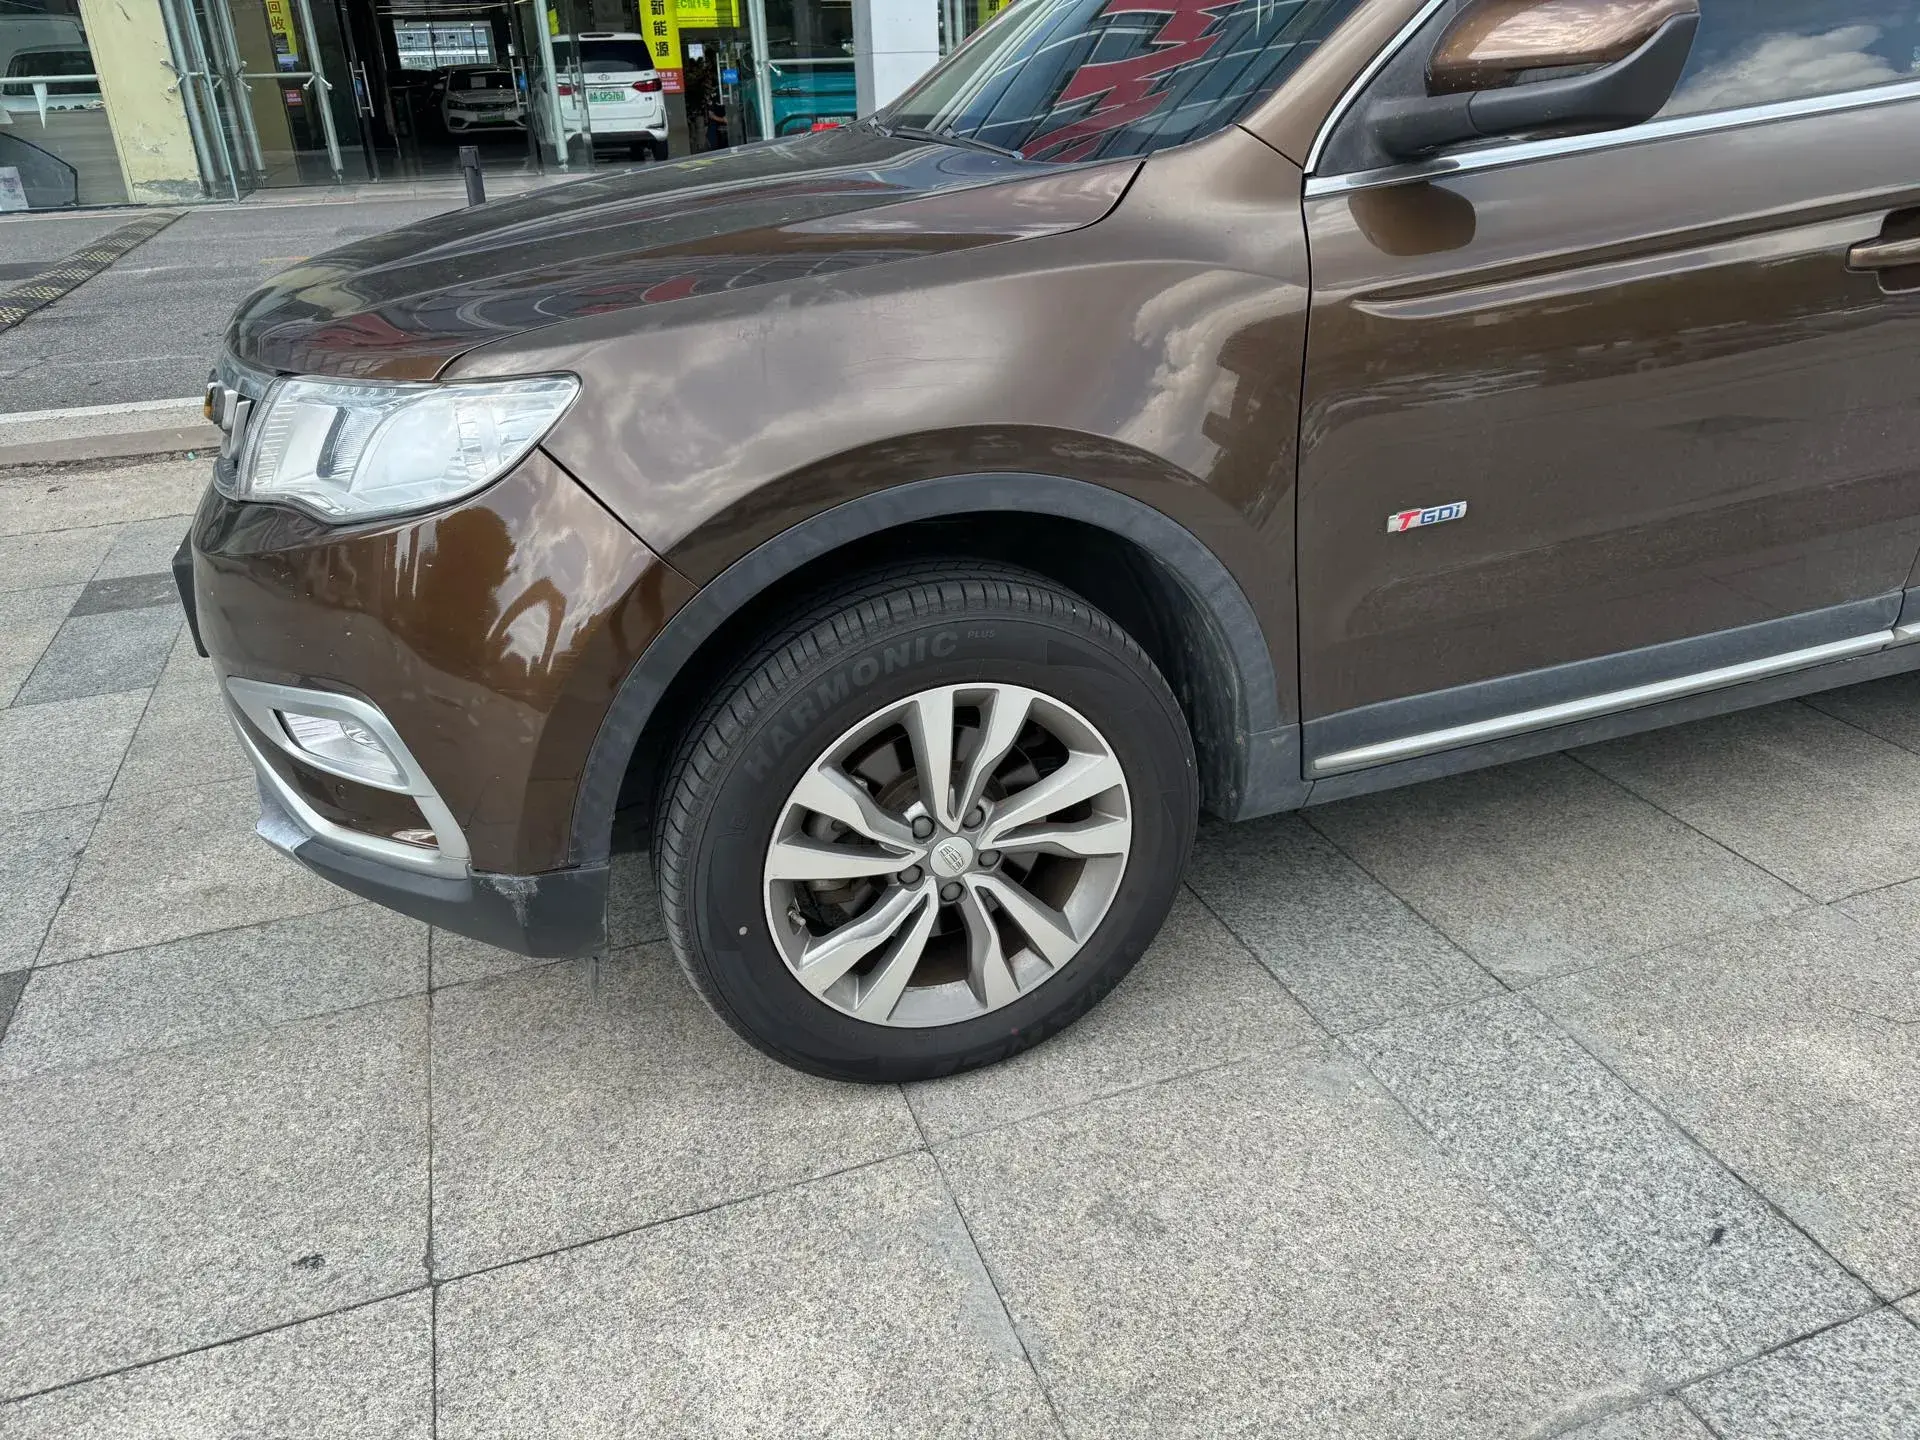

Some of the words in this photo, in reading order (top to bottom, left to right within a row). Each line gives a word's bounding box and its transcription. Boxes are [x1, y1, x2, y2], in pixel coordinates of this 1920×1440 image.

[268, 1, 285, 30] 回收
[651, 0, 669, 56] 新能源
[398, 504, 461, 530] TGDi
[744, 631, 958, 783] HARMONIC
[967, 629, 996, 639] PLUS
